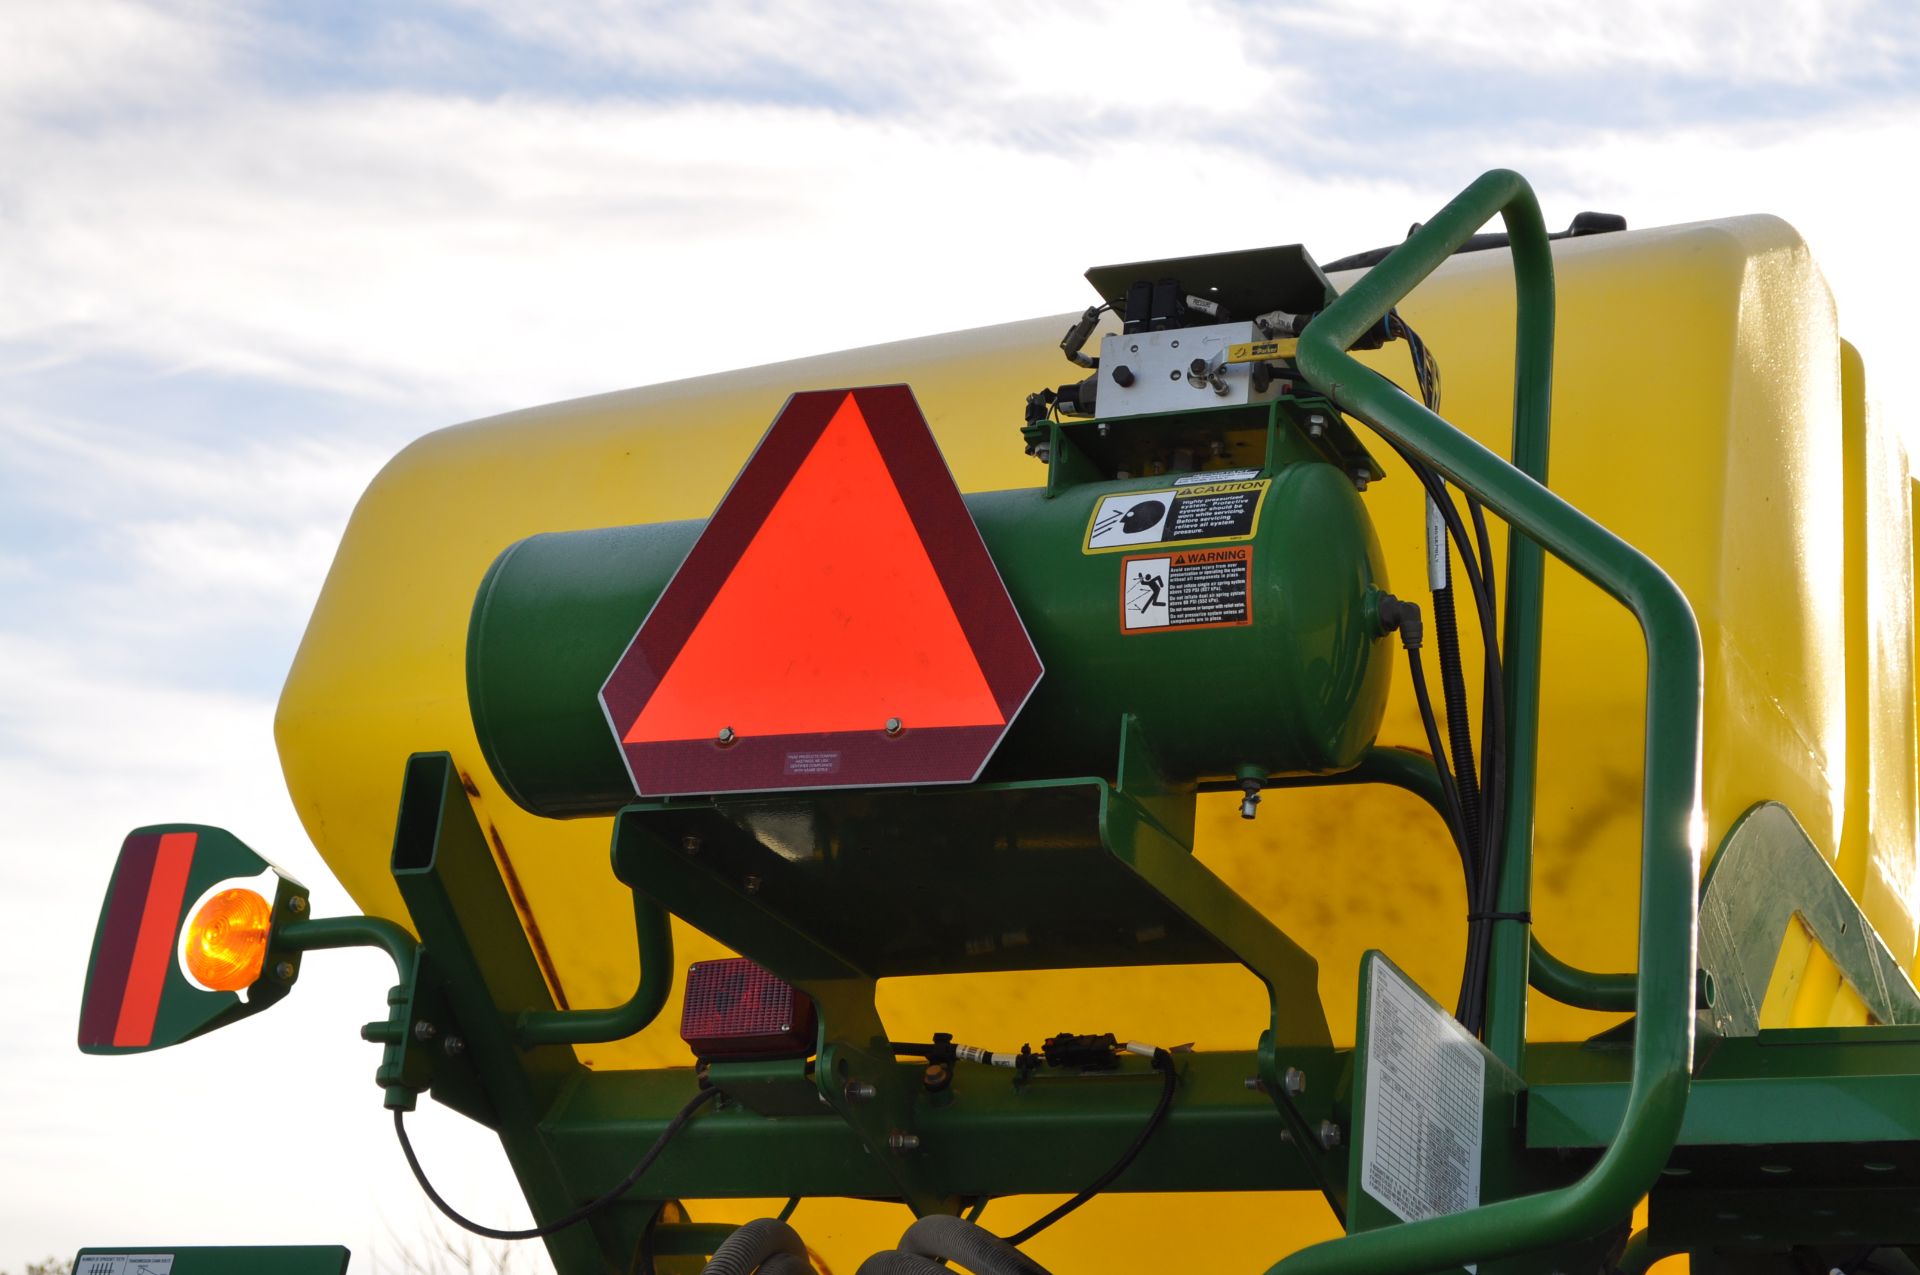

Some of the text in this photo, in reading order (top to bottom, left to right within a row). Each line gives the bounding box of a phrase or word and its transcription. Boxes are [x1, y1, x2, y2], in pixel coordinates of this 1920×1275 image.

[1194, 481, 1265, 494] CAUTION
[1205, 495, 1244, 503] pressurized
[1188, 550, 1246, 563] WARNING
